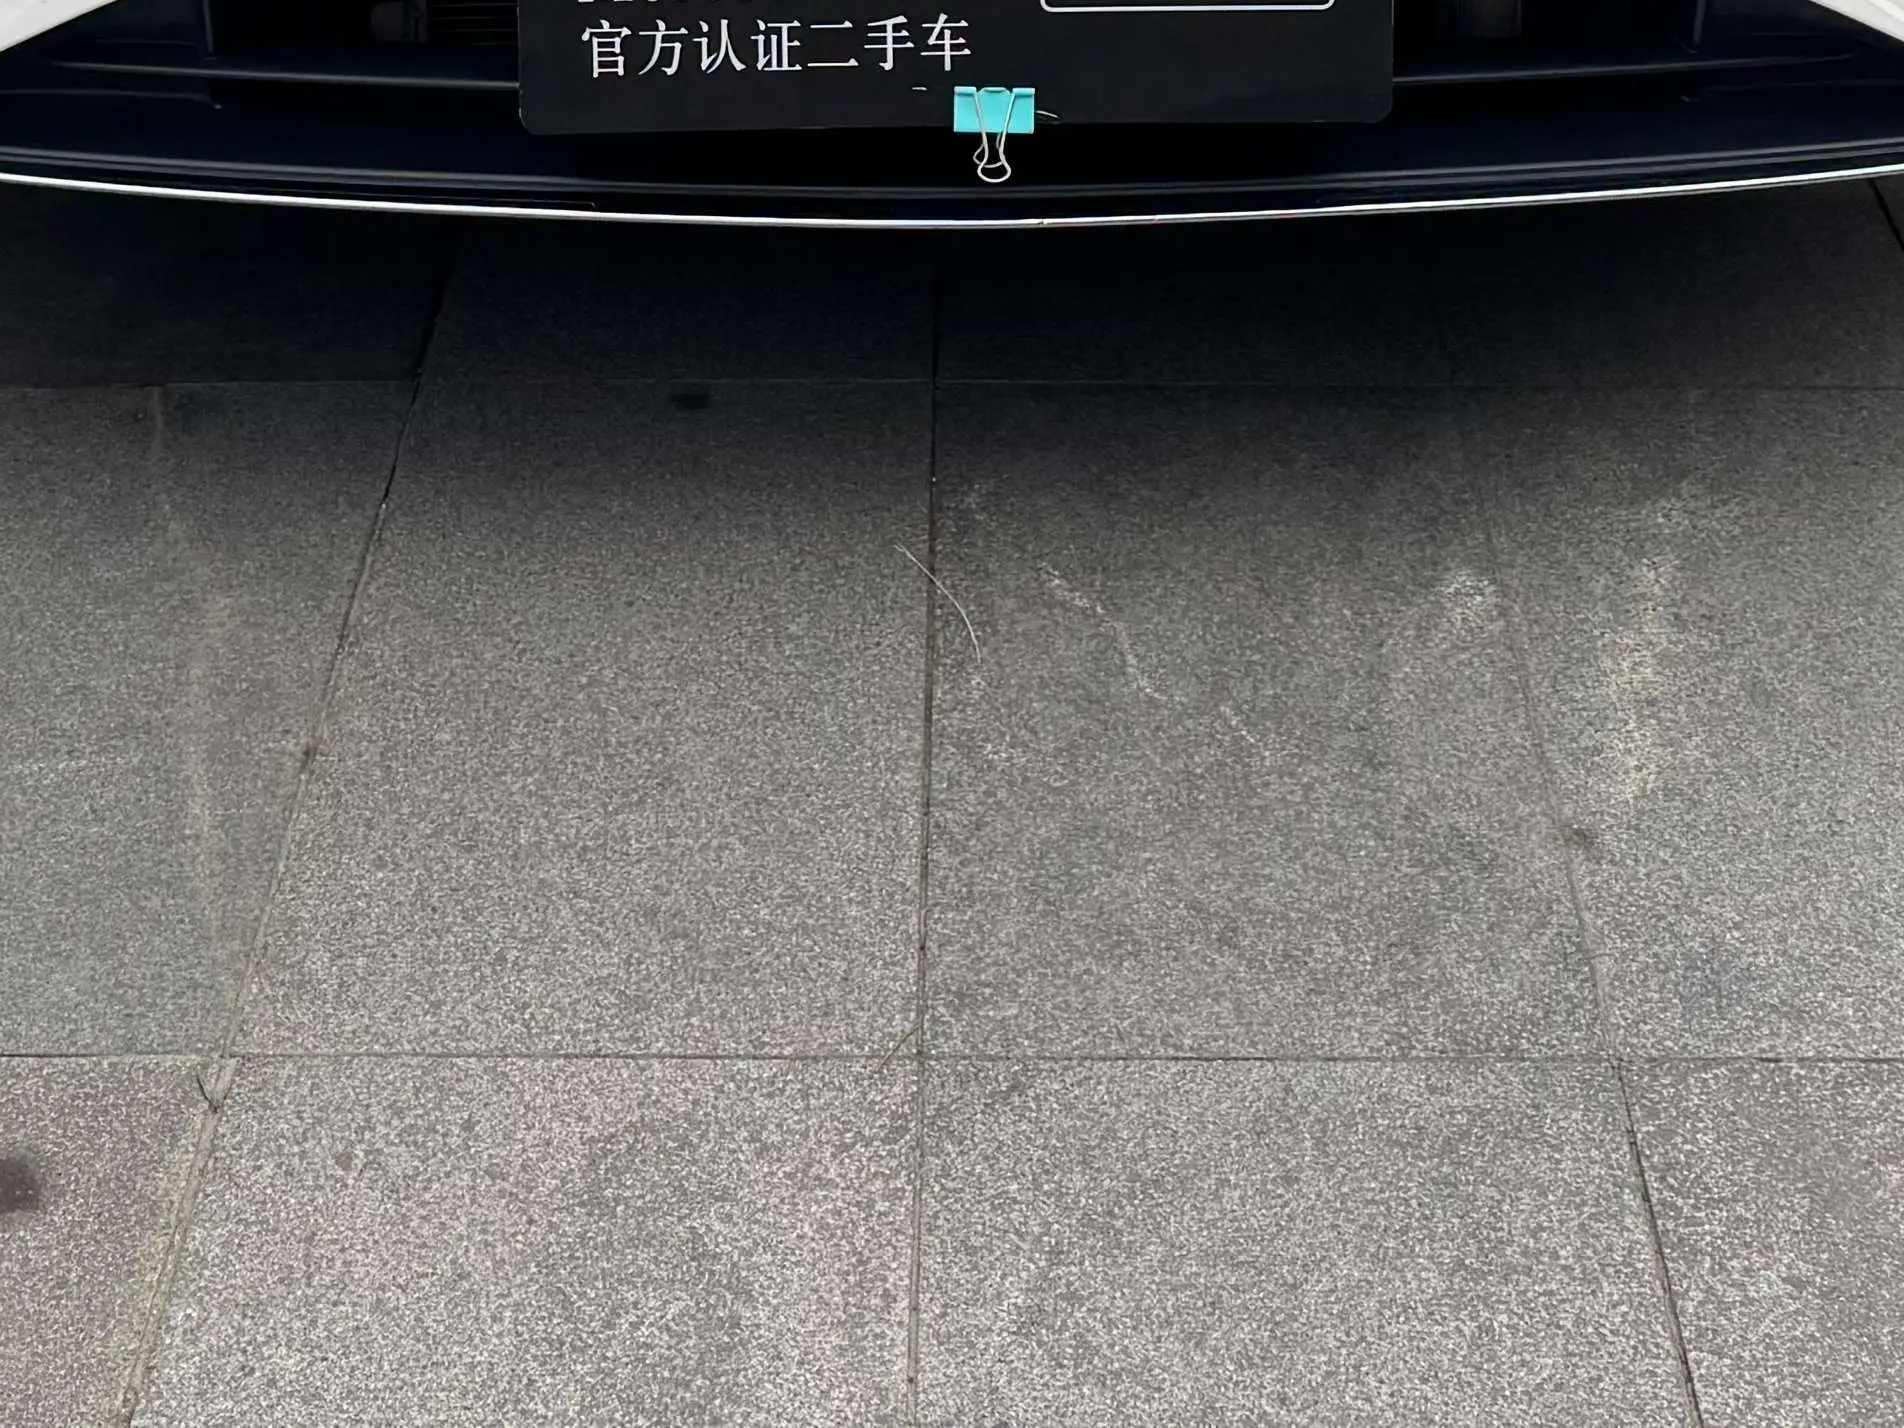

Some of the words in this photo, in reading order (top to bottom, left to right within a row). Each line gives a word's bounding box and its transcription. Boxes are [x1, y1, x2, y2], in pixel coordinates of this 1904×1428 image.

[581, 13, 972, 79] 官方认证二手车
